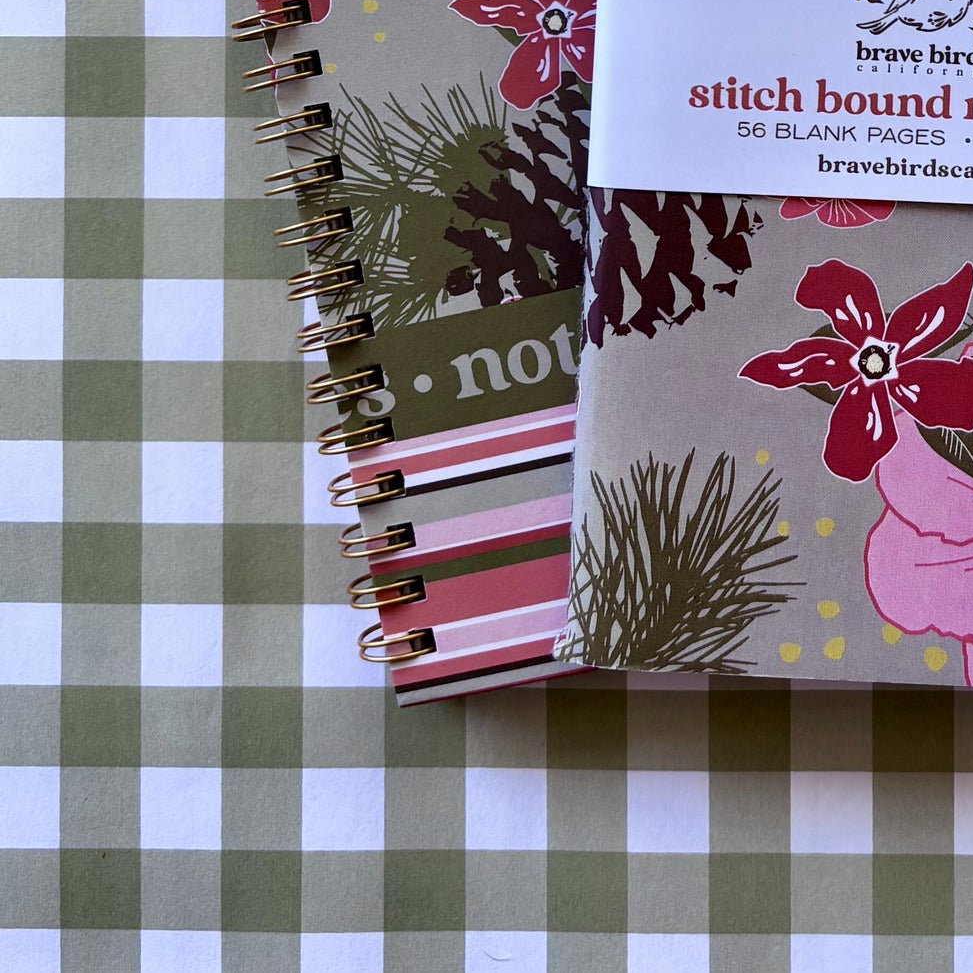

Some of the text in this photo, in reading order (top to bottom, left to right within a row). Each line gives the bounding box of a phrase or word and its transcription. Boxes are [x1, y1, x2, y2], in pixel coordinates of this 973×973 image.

[856, 40, 923, 63] brave
[688, 76, 804, 113] stitch
[815, 78, 952, 119] bound
[737, 122, 767, 138] 56
[775, 123, 857, 142] BLANK
[868, 127, 946, 146] PAGES
